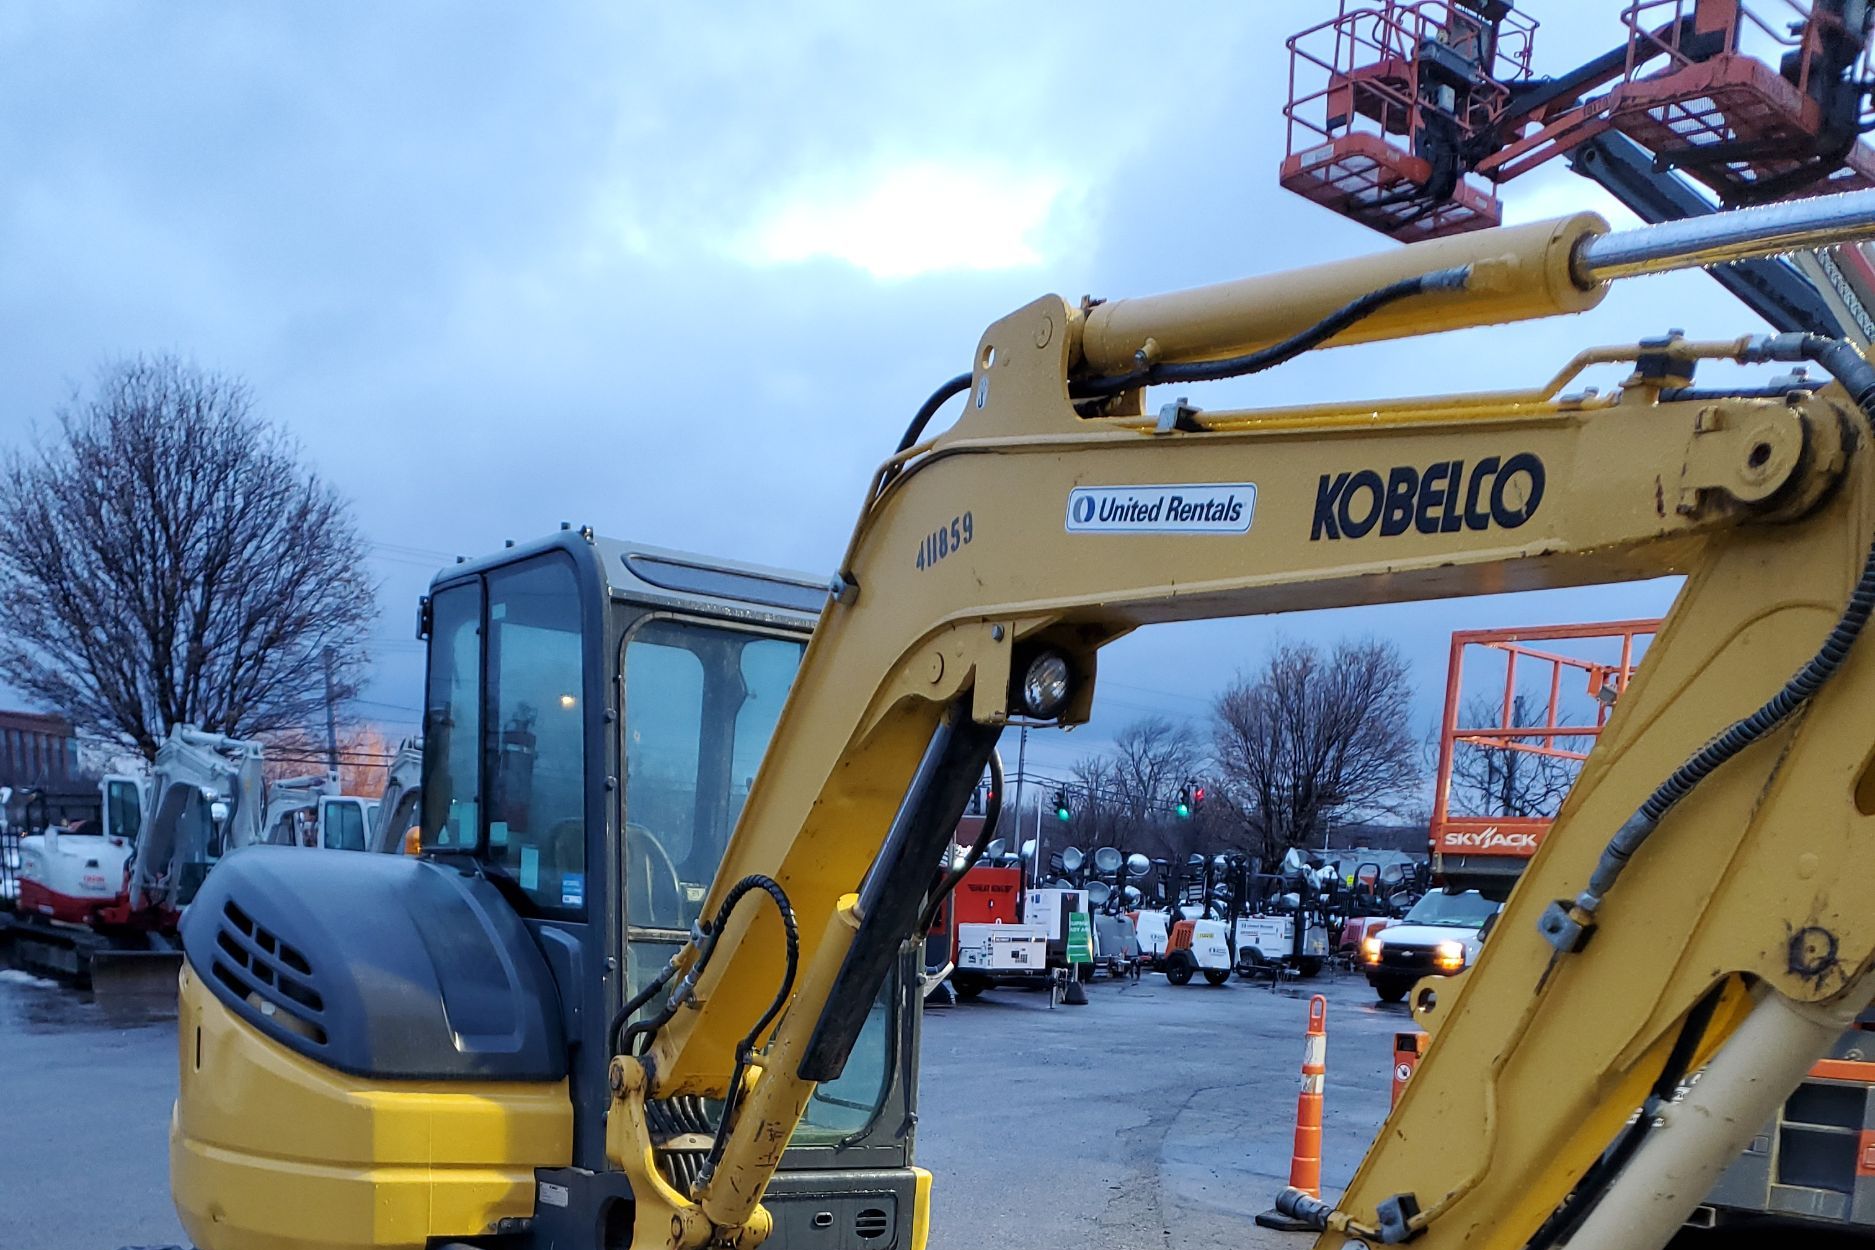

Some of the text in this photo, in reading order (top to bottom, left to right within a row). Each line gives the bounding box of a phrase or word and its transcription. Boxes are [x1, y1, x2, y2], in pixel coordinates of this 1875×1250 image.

[1099, 494, 1243, 522] United Rentals
[1310, 452, 1546, 541] KOBELCO
[916, 511, 973, 571] 411859
[1445, 827, 1537, 849] SKYJACK
